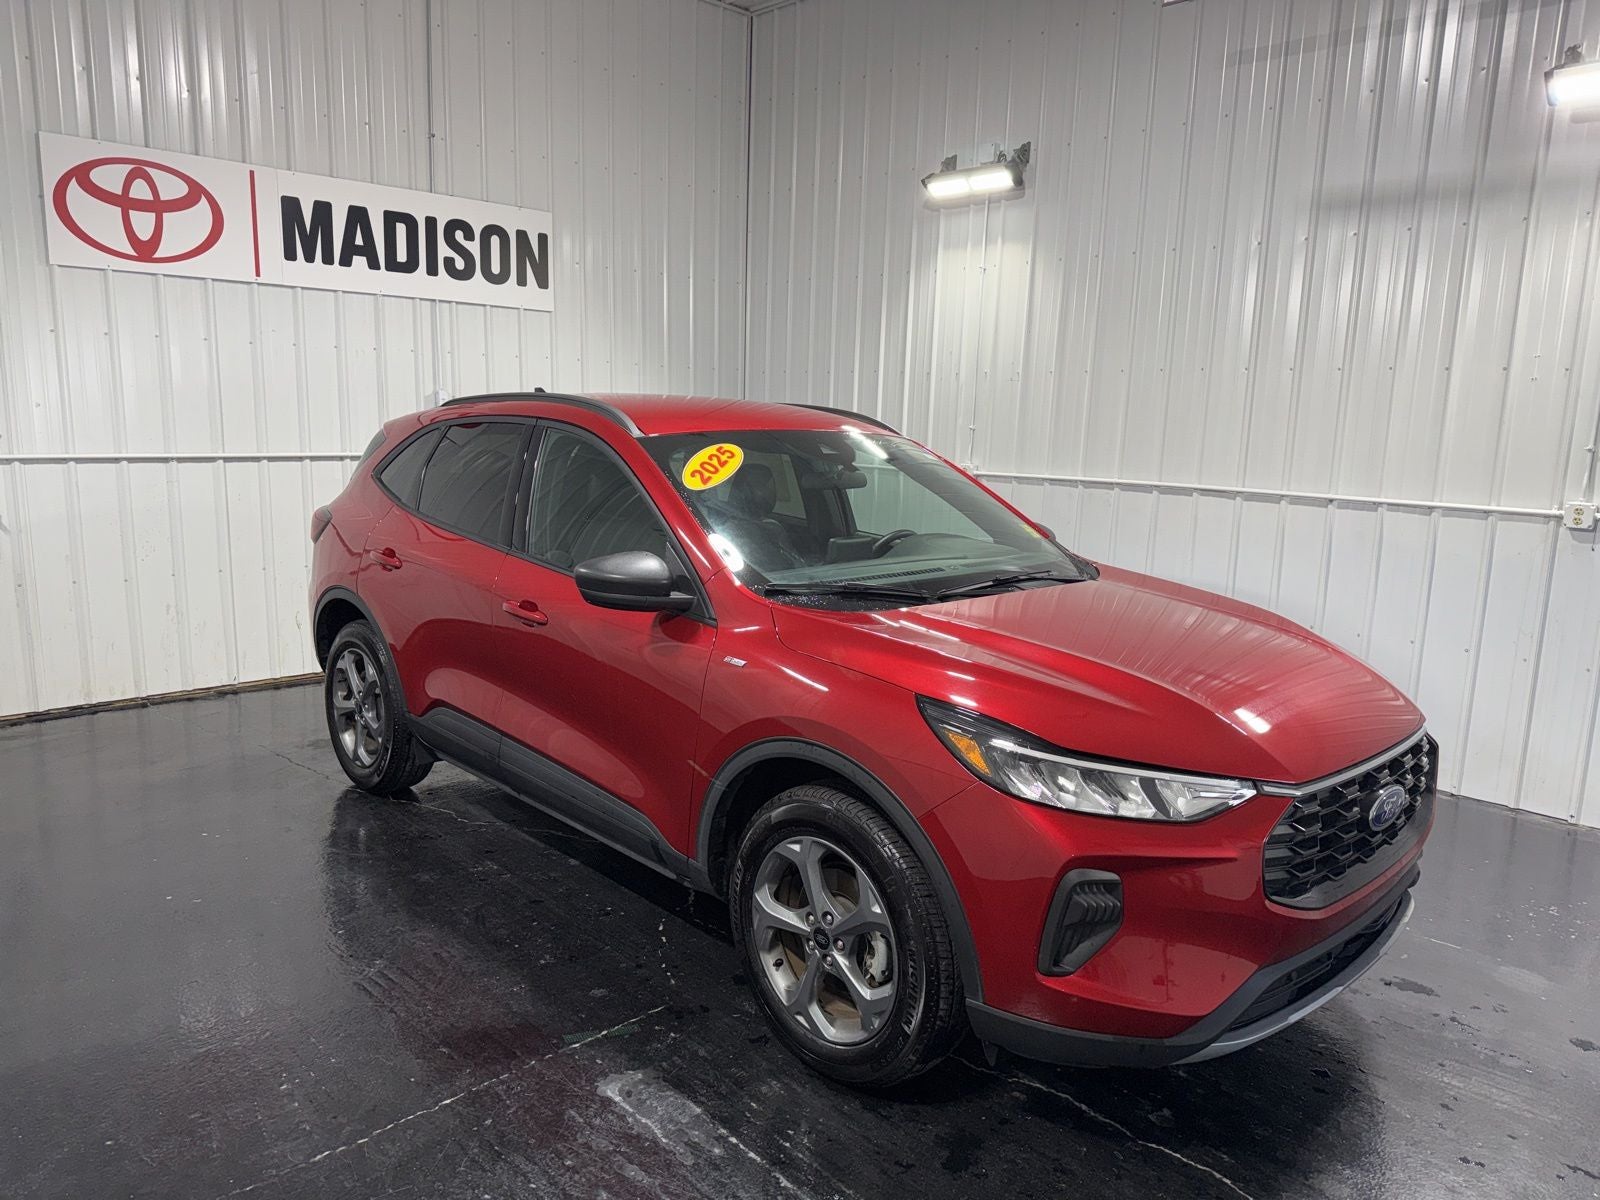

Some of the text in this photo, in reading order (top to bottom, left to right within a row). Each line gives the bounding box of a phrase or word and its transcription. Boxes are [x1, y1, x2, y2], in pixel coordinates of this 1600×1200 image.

[280, 195, 549, 290] MADISON
[690, 446, 736, 486] 2025
[901, 944, 921, 1036] MICHELIN
